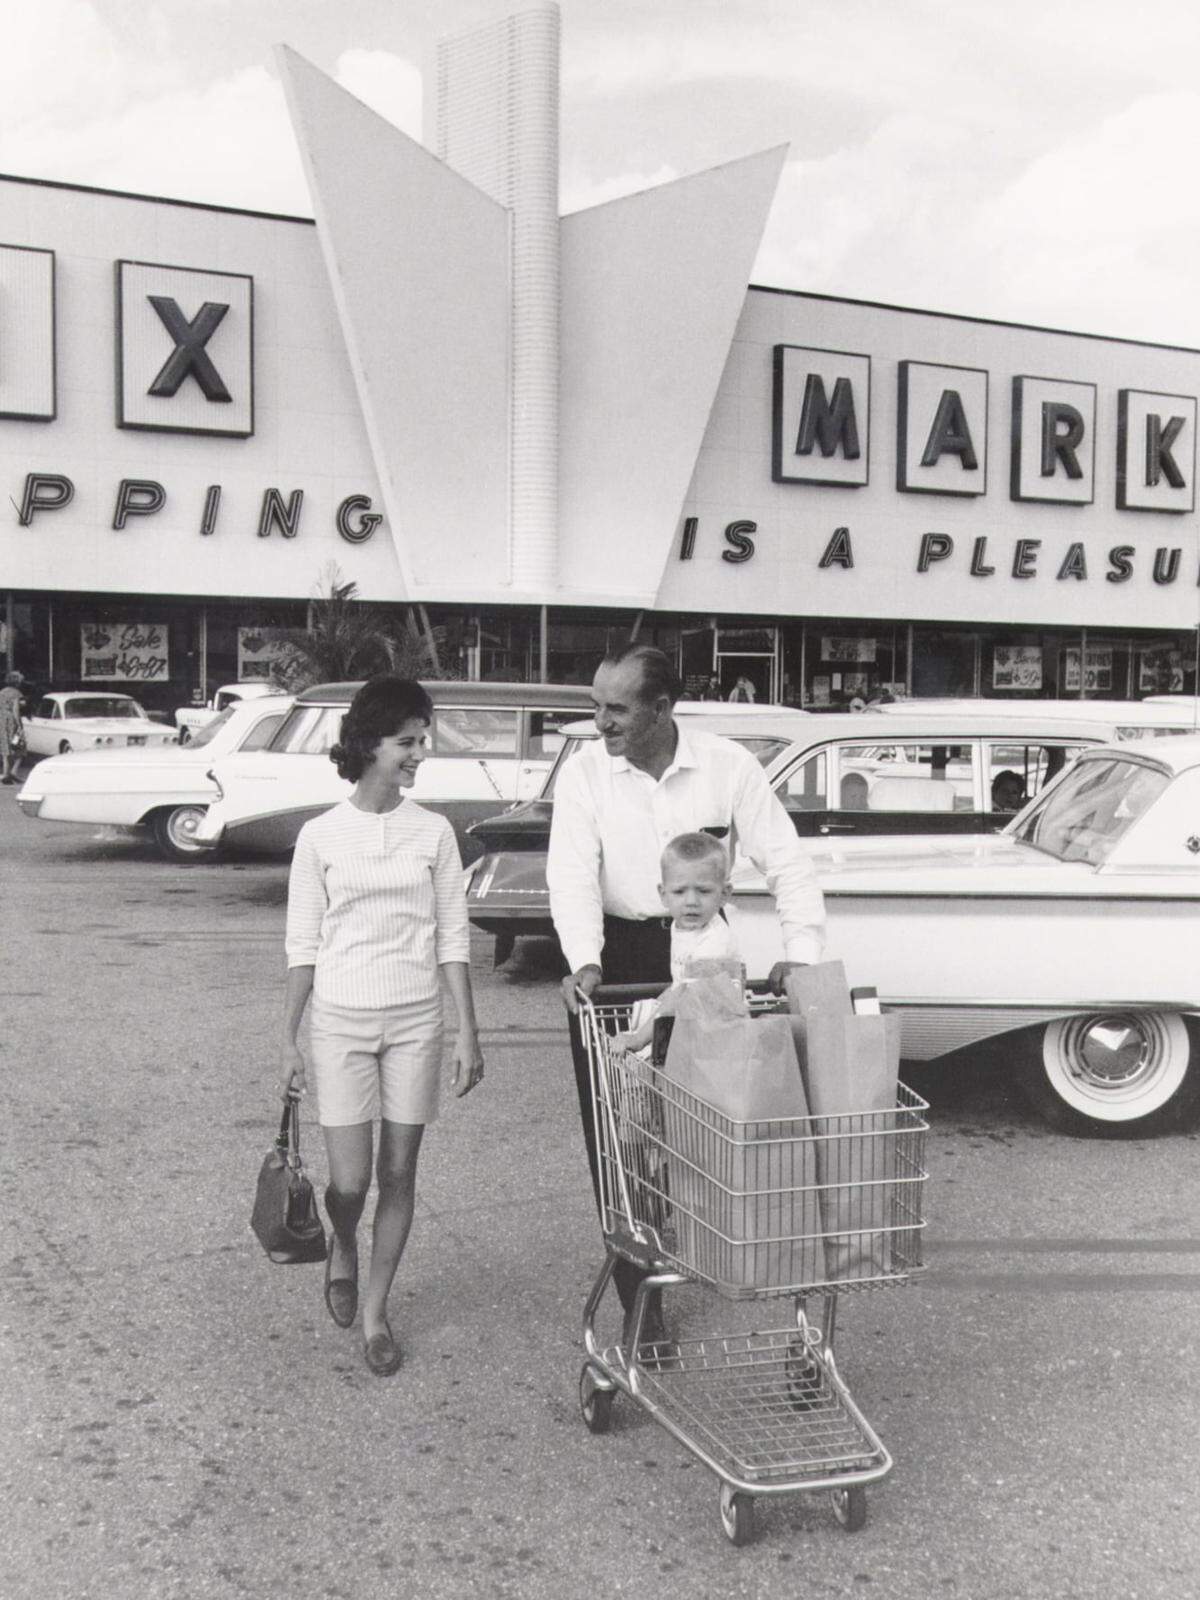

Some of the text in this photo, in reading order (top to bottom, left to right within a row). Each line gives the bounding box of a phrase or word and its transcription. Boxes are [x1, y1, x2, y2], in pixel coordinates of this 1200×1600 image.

[146, 295, 233, 402] X
[795, 373, 1187, 489] MARK
[18, 473, 383, 544] PPING
[680, 517, 1200, 588] IS A PLEASU
